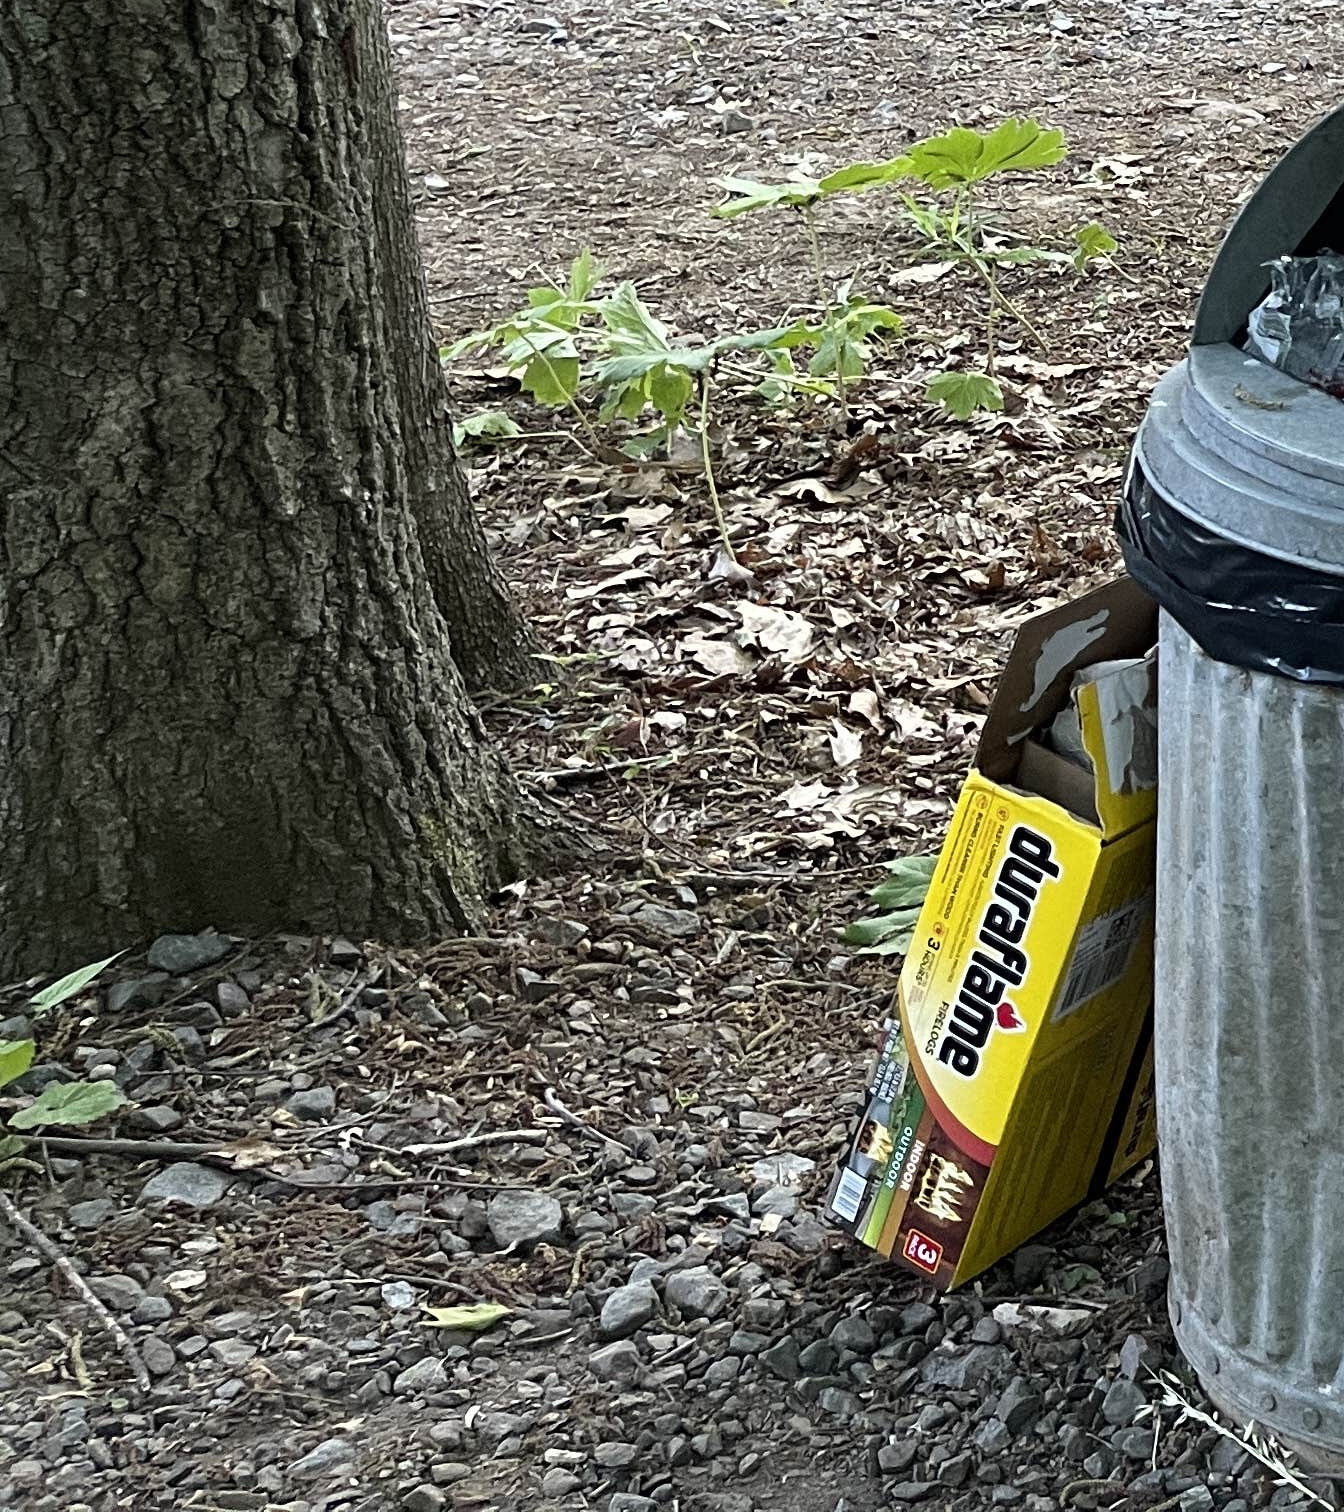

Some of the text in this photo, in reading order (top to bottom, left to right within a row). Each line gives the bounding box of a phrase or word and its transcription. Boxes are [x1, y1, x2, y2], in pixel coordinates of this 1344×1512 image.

[926, 936, 941, 951] 3
[939, 826, 1060, 1077] duraflame
[925, 1001, 950, 1056] FIRELOGS
[885, 1125, 914, 1192] OUTDOOR
[899, 1138, 925, 1193] INDOOR
[915, 1241, 938, 1266] 3
